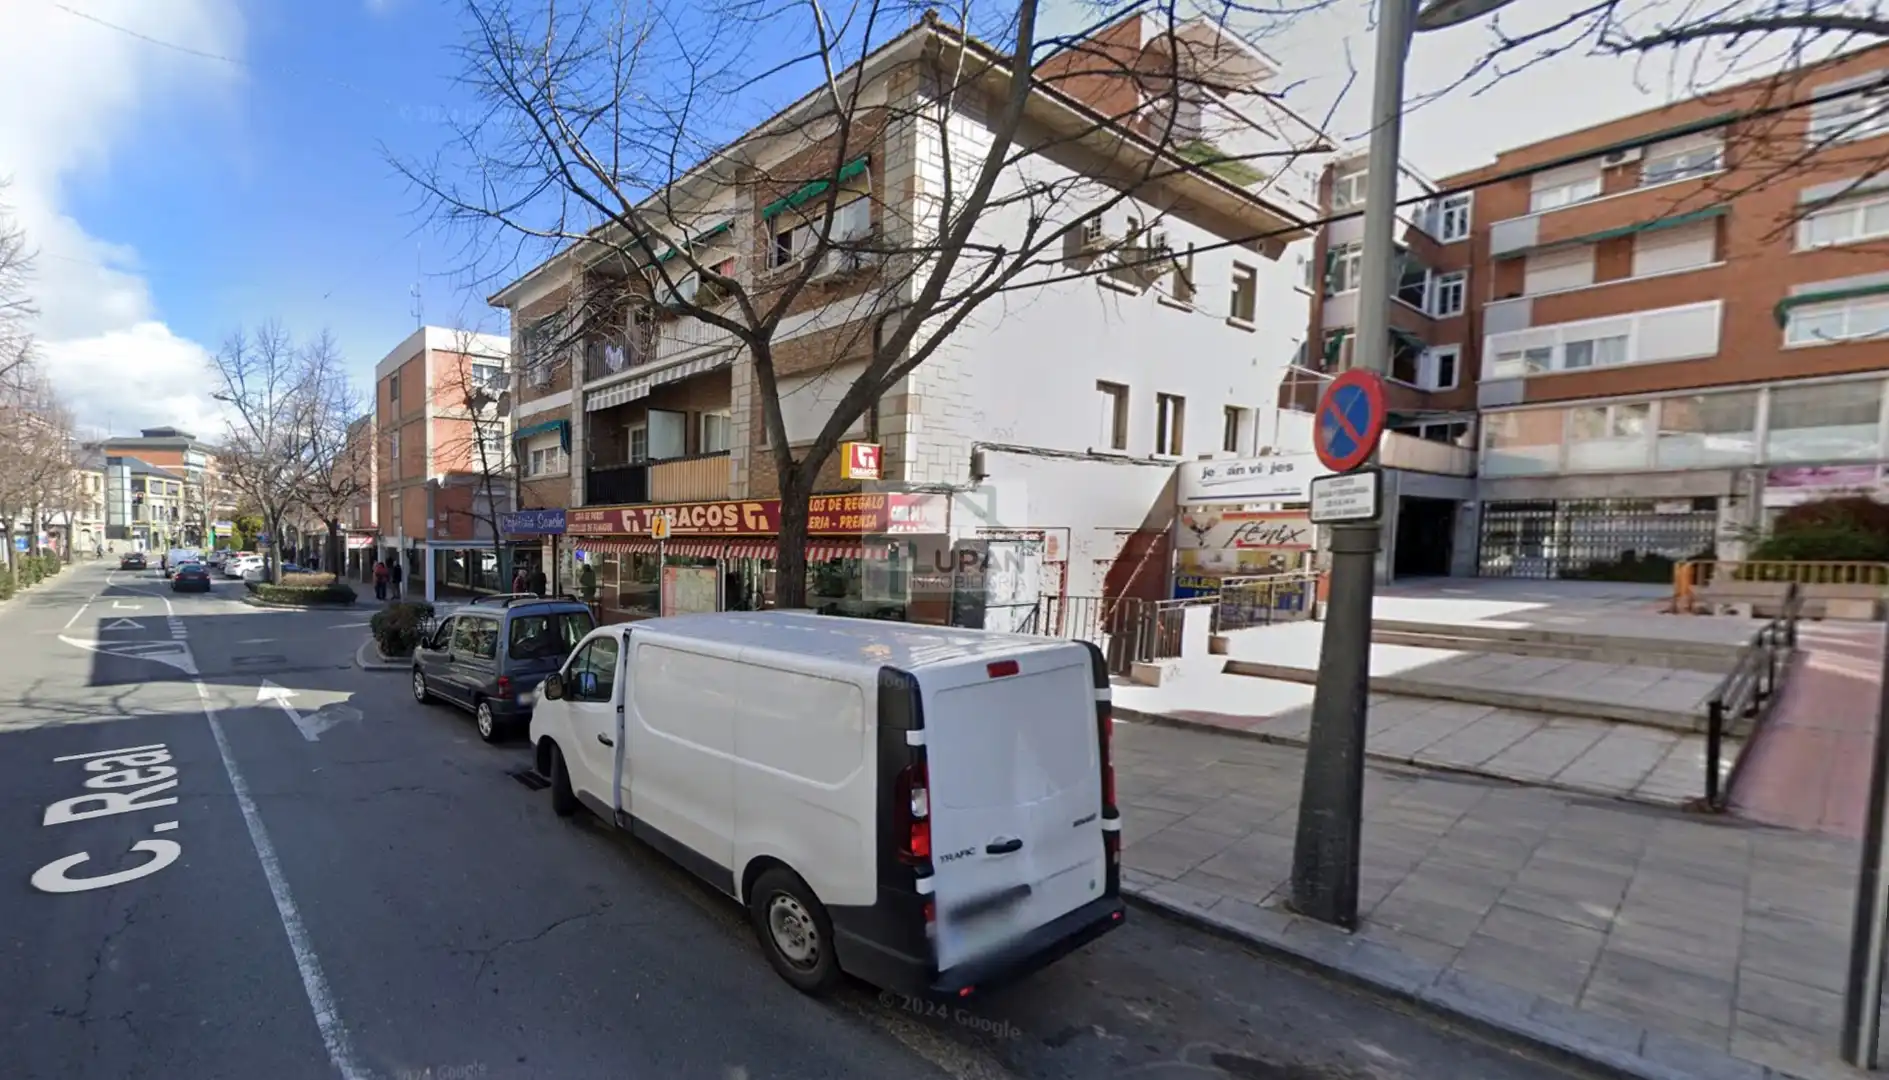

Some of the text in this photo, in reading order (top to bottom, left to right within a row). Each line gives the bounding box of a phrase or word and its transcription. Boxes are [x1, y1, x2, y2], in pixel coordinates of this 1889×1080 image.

[828, 497, 843, 512] DE
[844, 495, 884, 511] REGALO
[642, 504, 740, 528] TBACOS
[808, 515, 831, 529] ERIA
[839, 514, 877, 529] PRENSA
[1222, 520, 1307, 549] fénix
[30, 743, 182, 893] C. Real
[939, 846, 976, 864] TRAFIC
